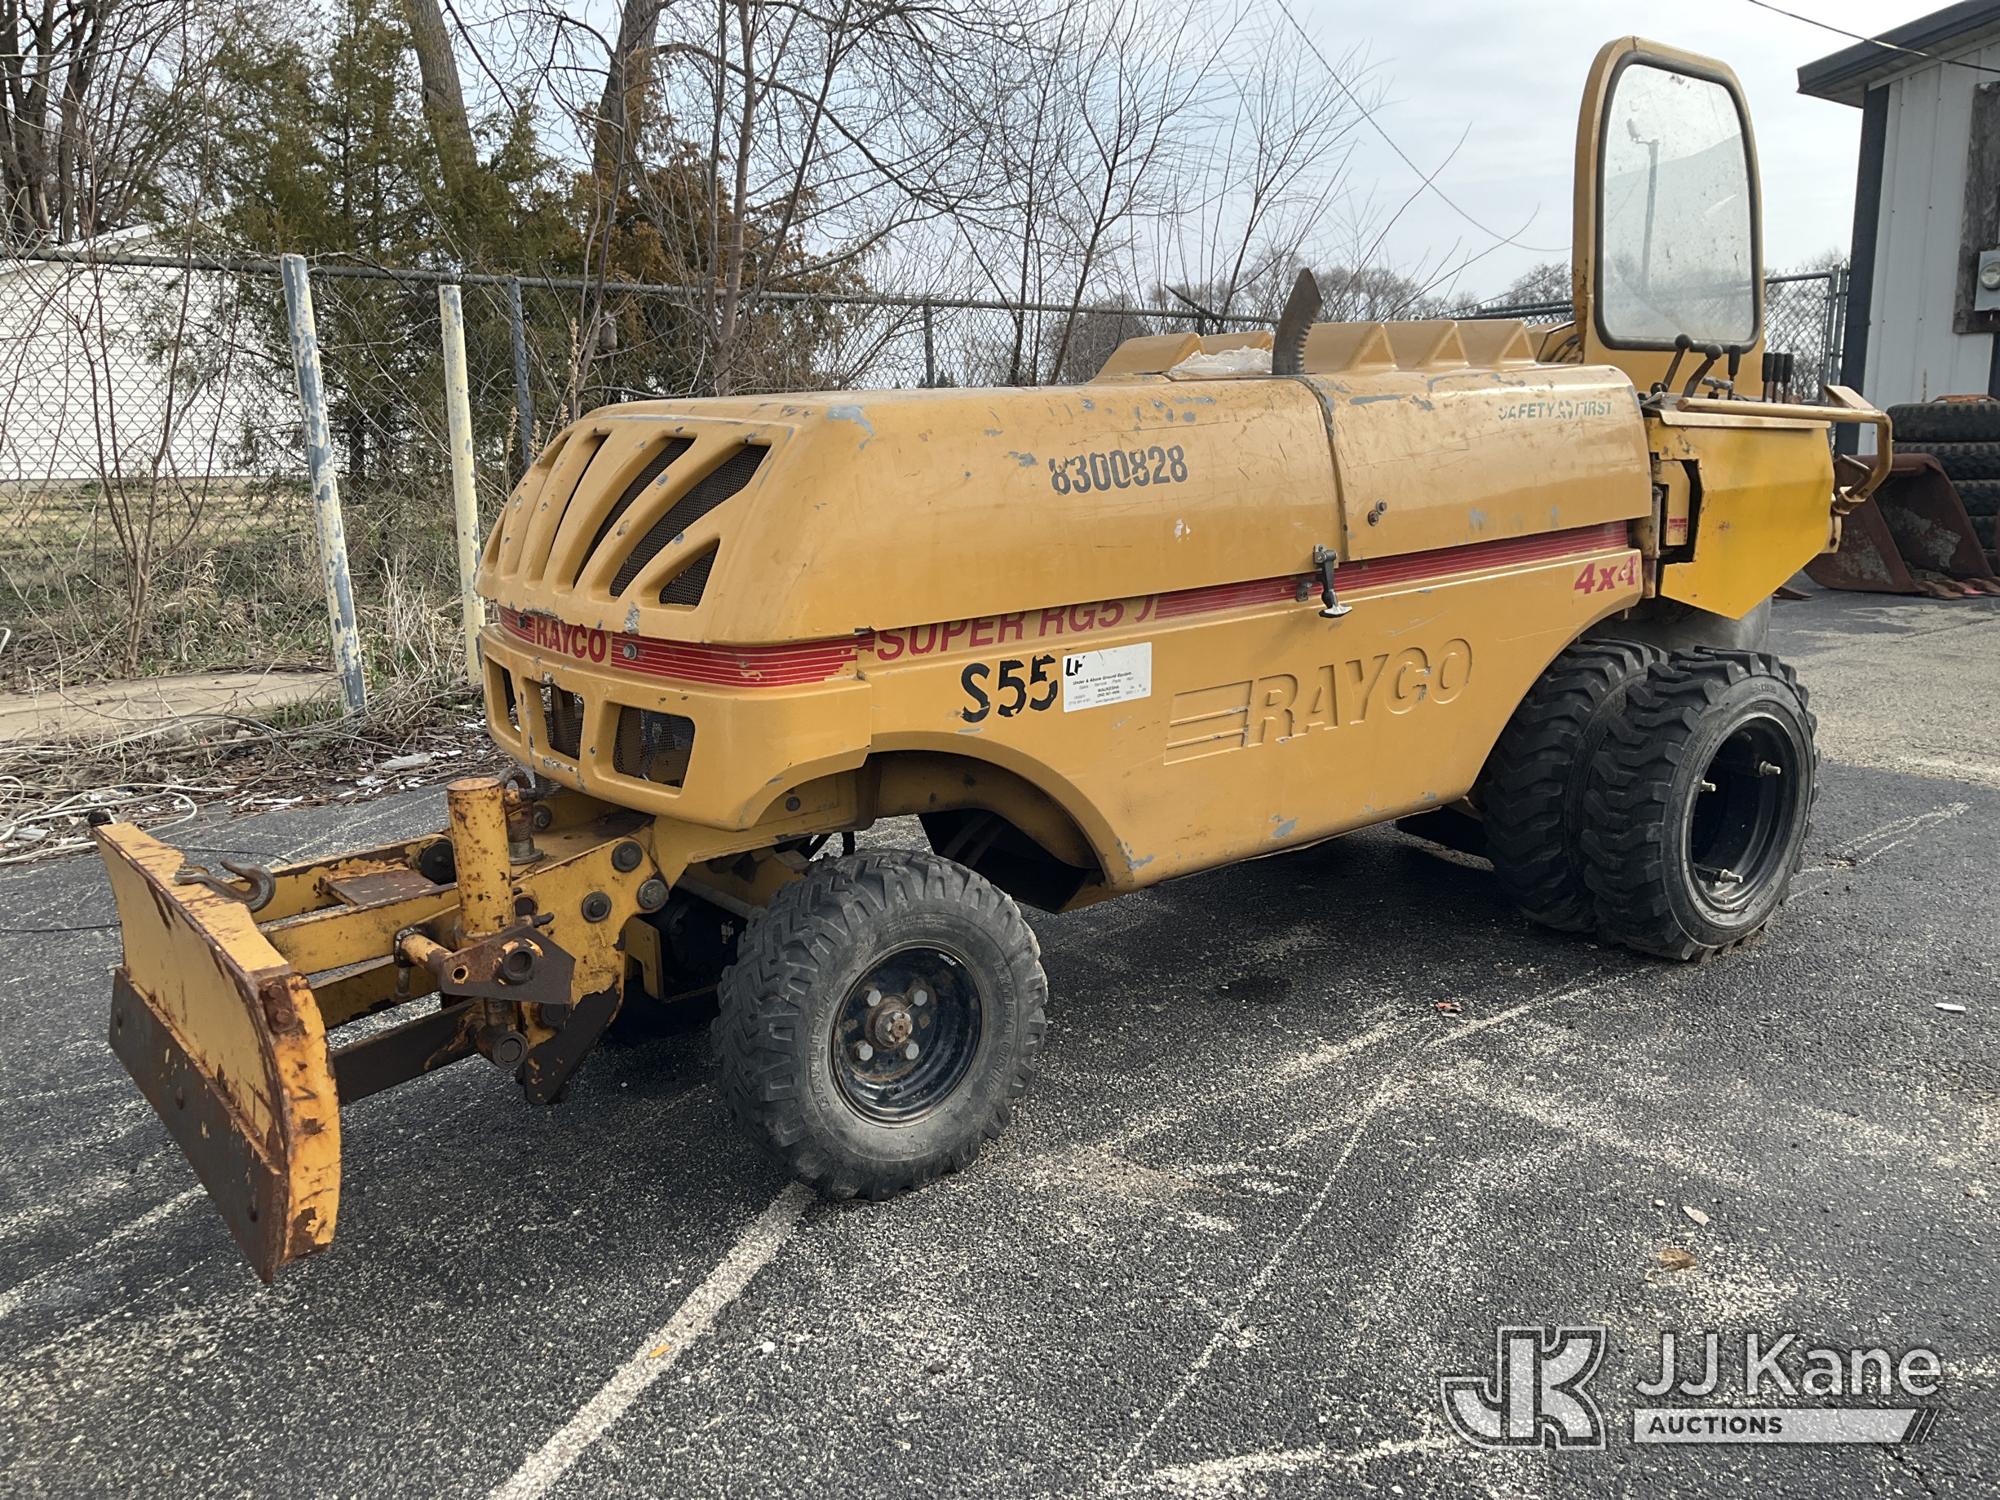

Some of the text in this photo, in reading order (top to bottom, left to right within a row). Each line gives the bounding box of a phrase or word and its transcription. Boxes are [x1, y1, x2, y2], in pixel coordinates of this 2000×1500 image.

[1048, 444, 1188, 495] 8300828
[1573, 555, 1638, 595] 4x4
[536, 613, 607, 663] RAYCO
[876, 611, 1026, 661] SUPER
[960, 654, 1058, 723] S55
